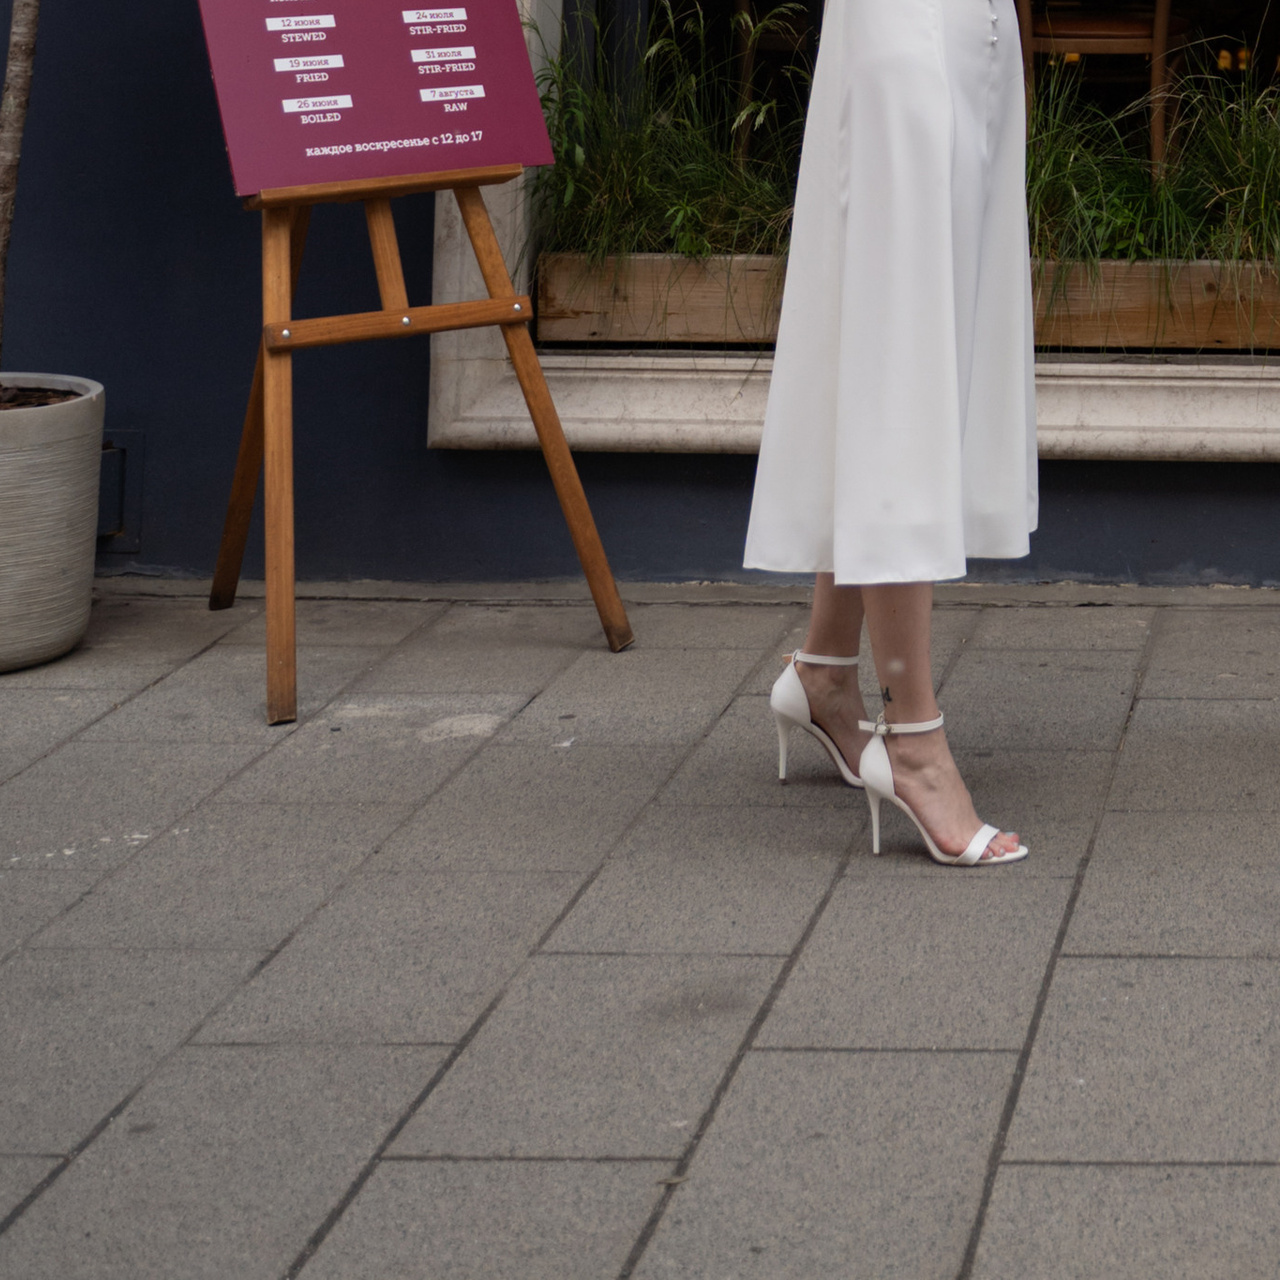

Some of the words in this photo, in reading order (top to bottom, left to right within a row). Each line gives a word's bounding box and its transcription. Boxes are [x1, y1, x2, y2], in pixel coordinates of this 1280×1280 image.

[416, 11, 427, 20] 24
[429, 11, 454, 19] июля
[281, 19, 292, 27] 12
[294, 19, 321, 27] июня
[409, 24, 467, 35] STIR-FRIED
[281, 32, 326, 43] STEWED
[425, 50, 435, 59] 31
[437, 50, 462, 58] июля
[289, 59, 301, 68] 19
[302, 59, 329, 67] июня
[418, 62, 476, 75] STIR-FRIED
[296, 72, 329, 83] FRIED
[430, 90, 436, 98] 7
[438, 89, 475, 98] августа
[297, 99, 310, 109] 26
[311, 99, 339, 108] июня
[444, 102, 468, 112] RAW
[301, 112, 341, 124] BOILED
[306, 143, 353, 157] каждое
[355, 136, 430, 152] воскресенье
[432, 137, 439, 145] с
[440, 133, 453, 144] 12
[455, 134, 470, 144] до
[470, 131, 483, 141] 17
